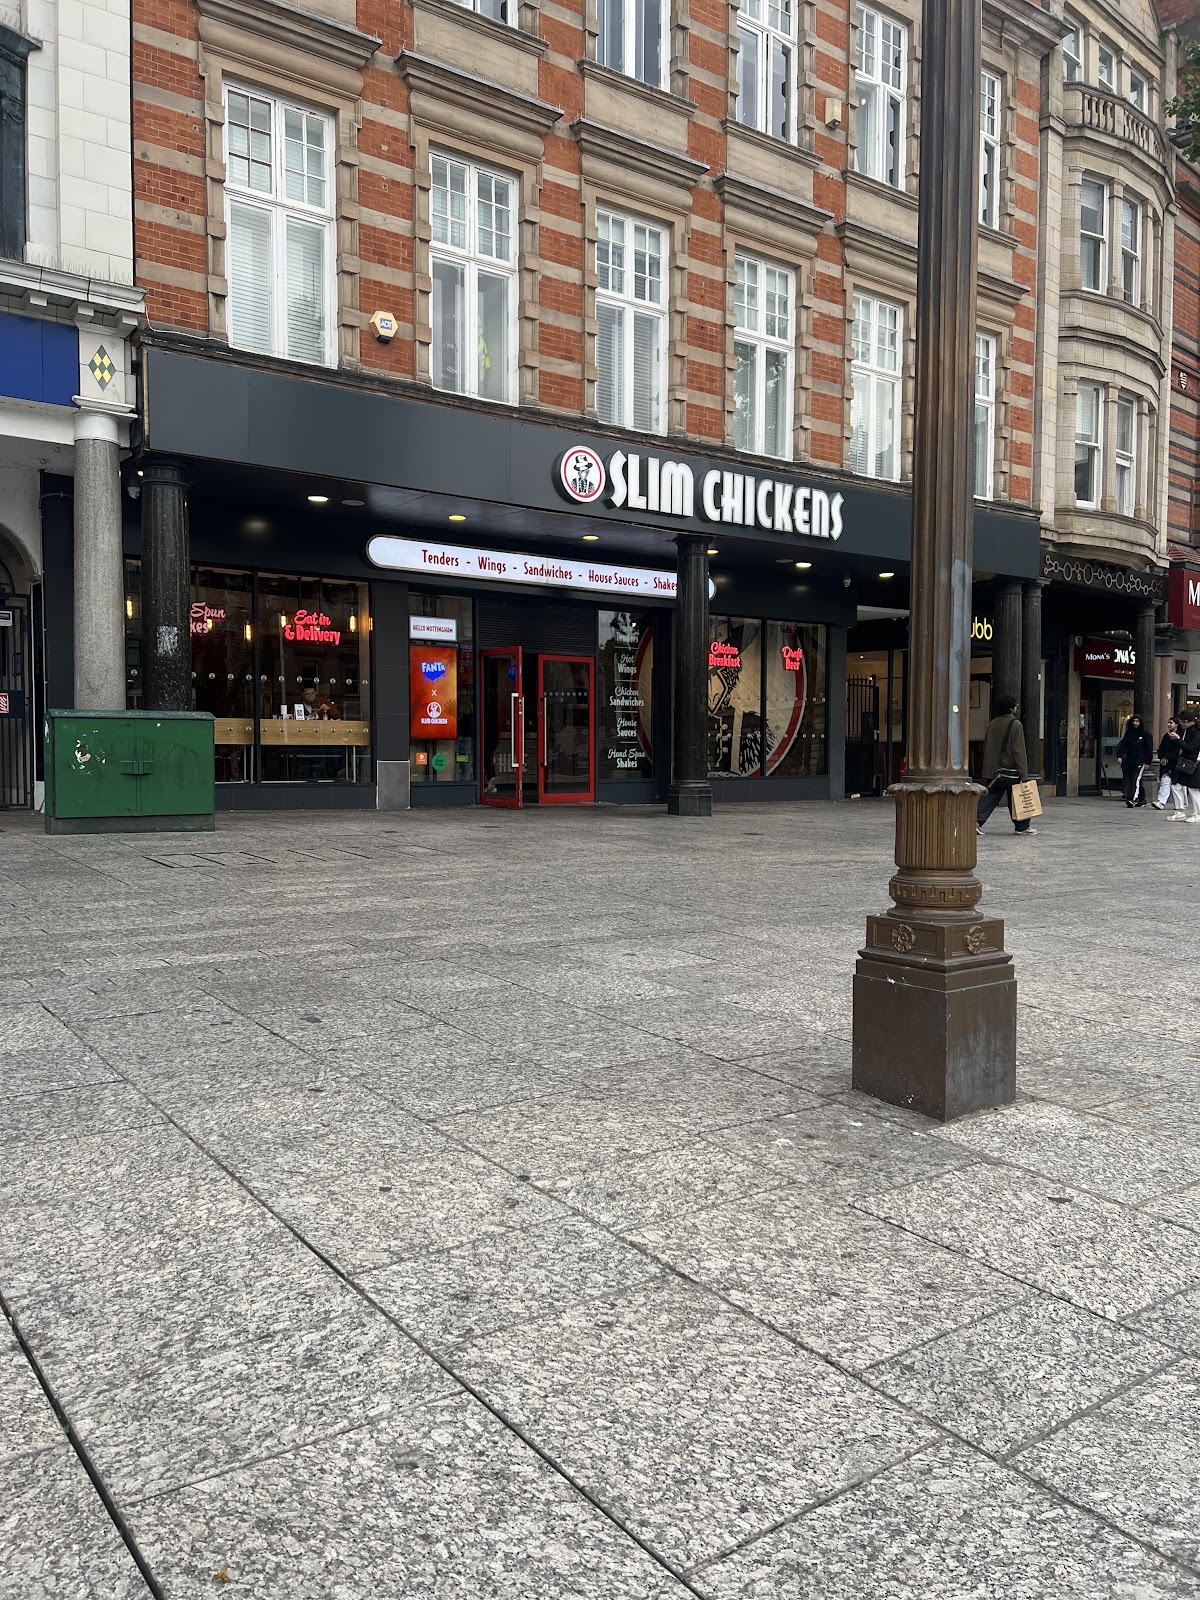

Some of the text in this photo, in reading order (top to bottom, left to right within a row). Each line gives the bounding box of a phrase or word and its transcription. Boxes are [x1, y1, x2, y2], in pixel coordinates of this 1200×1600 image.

[609, 450, 844, 541] SLIM CHICKENS
[422, 549, 459, 567] Tenders
[478, 556, 506, 574] Wings
[523, 562, 572, 579] Sandwiches
[588, 570, 612, 584] House
[614, 572, 639, 587] Sauces
[190, 601, 226, 621] Spun
[294, 610, 331, 626] Eat in
[284, 624, 341, 645] & Delivery
[426, 625, 454, 633] NOTTINGHAM
[710, 641, 739, 655] Chicken
[781, 646, 802, 661] Draft
[620, 653, 635, 663] Hot
[708, 653, 740, 667] Breakfast
[617, 663, 637, 675] Wings
[785, 659, 800, 670] Beer
[614, 686, 639, 697] Chicken
[609, 696, 645, 707] Sandwiches
[616, 717, 637, 728] House
[616, 727, 637, 737] Sauces
[607, 748, 646, 760] Hand Spun
[616, 758, 638, 768] Shakes
